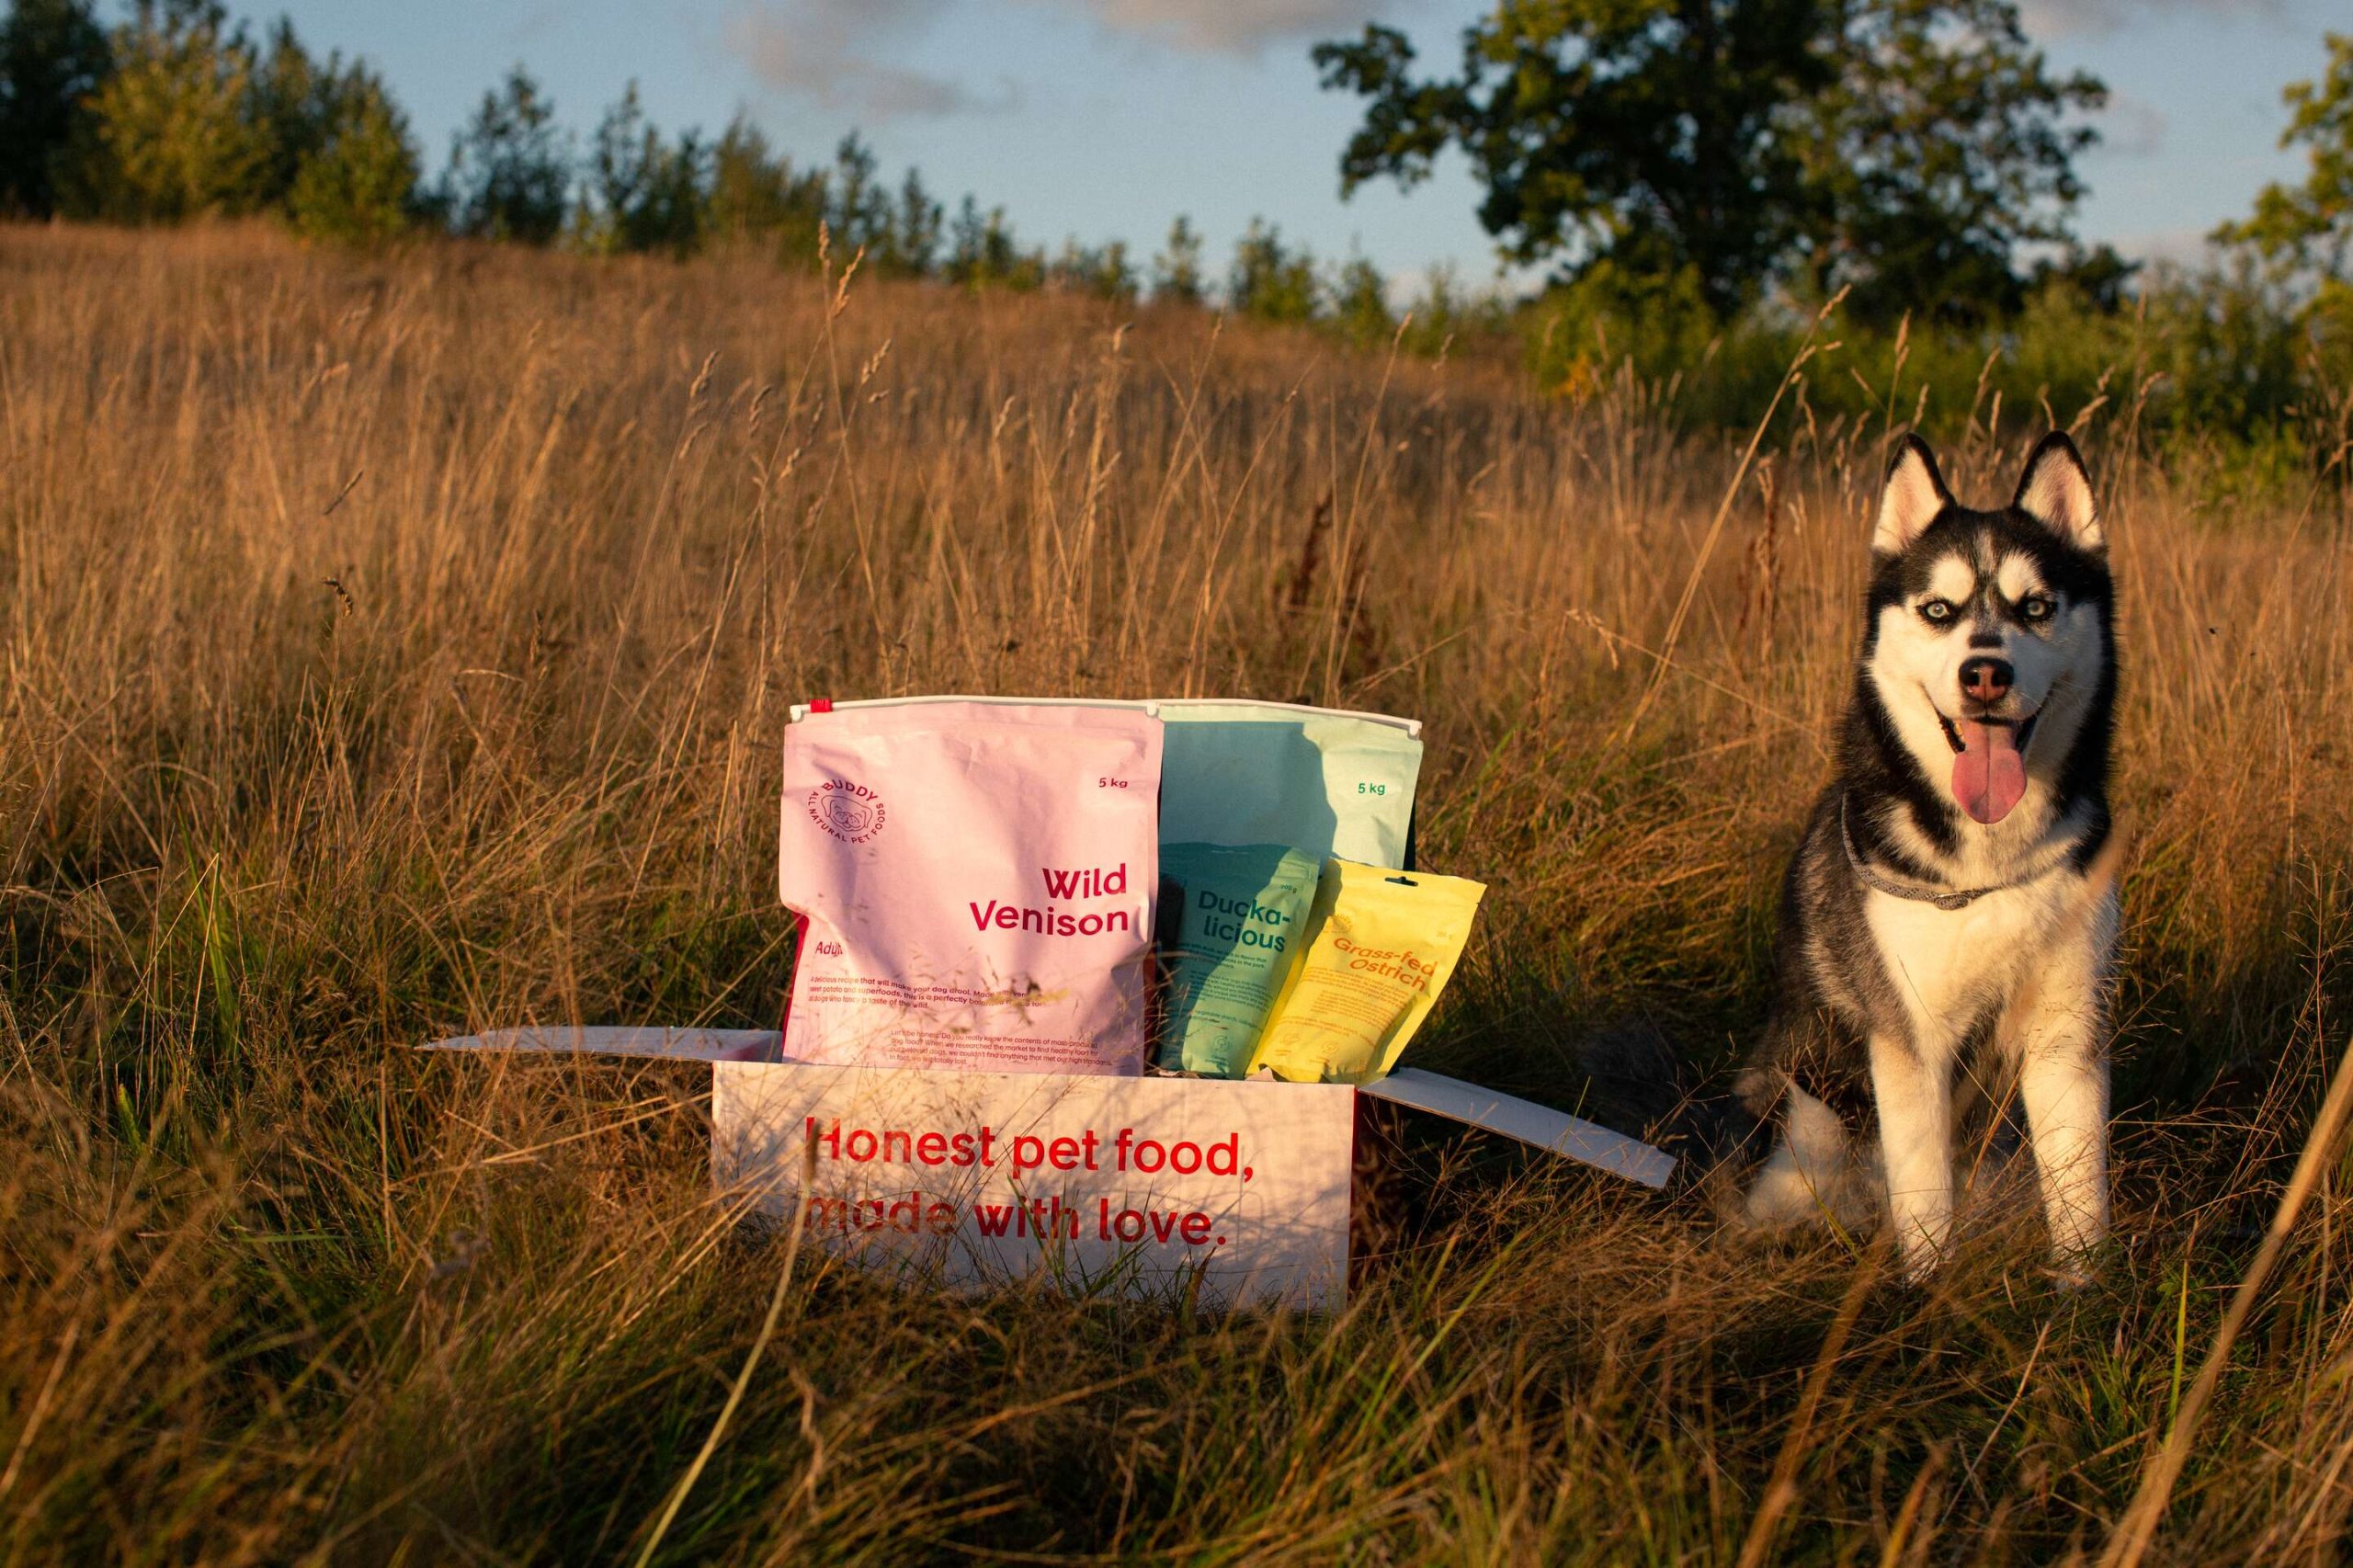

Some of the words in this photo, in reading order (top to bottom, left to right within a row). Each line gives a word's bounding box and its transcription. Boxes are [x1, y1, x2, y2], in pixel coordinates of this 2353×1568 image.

[822, 779, 878, 801] BUDDY
[1098, 778, 1107, 788] 5
[1110, 778, 1128, 789] kg
[1358, 783, 1366, 794] 5
[1370, 783, 1385, 796] kg
[808, 791, 819, 806] ALL
[809, 809, 847, 842] NATURAL
[870, 803, 885, 835] FOODS
[851, 834, 870, 844] PET
[1042, 863, 1126, 900] Wild
[1198, 890, 1290, 926] Ducka-
[970, 900, 1129, 937] Venison
[1204, 915, 1286, 953] licious
[1333, 937, 1438, 977] Grass-fed
[860, 977, 875, 985] that
[892, 981, 912, 992] make
[914, 986, 931, 995] your
[932, 986, 948, 995] dog
[1348, 959, 1427, 993] Ostrich
[869, 997, 888, 1006] taste
[899, 999, 911, 1007] the
[904, 993, 917, 1001] this
[933, 994, 967, 1005] perfectly
[1014, 1037, 1041, 1045] contents
[933, 1057, 954, 1065] totally
[1000, 1053, 1028, 1062] anything
[1068, 1057, 1083, 1065] high
[1051, 1048, 1074, 1056] healthy
[804, 1117, 995, 1167] Honest
[1012, 1130, 1099, 1179] pet
[1114, 1128, 1254, 1183] food,
[804, 1190, 957, 1236] made
[973, 1196, 1079, 1240] with
[1098, 1198, 1227, 1246] love.
